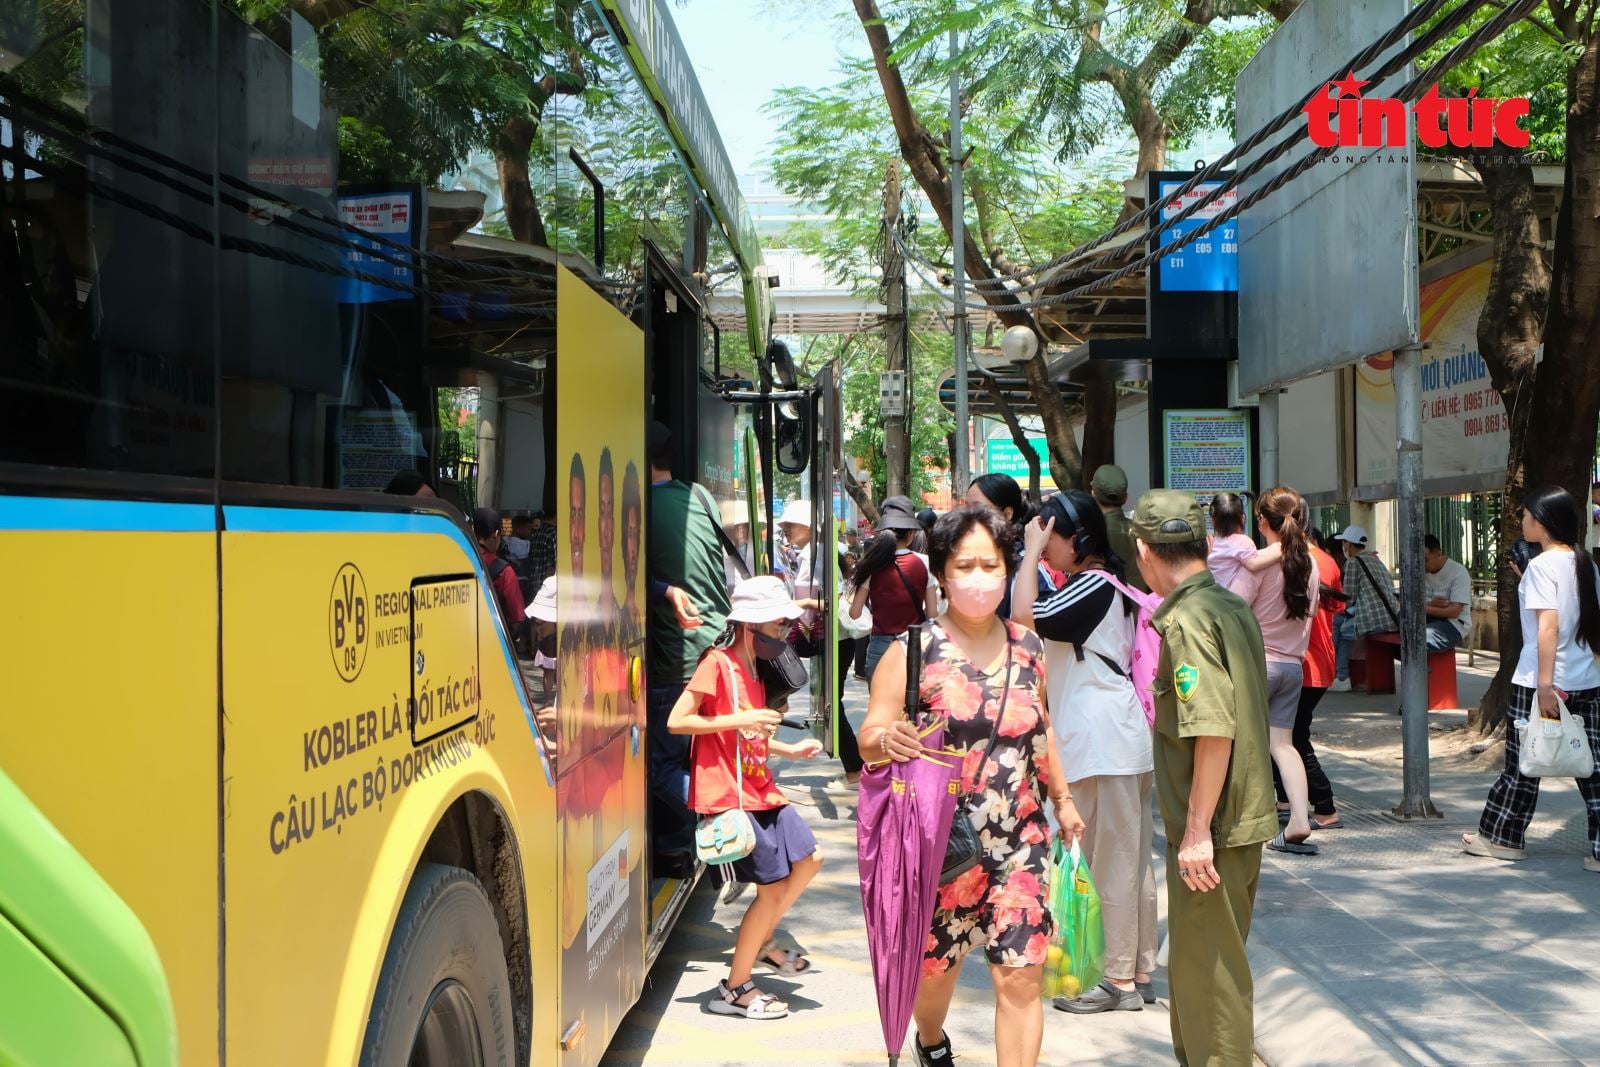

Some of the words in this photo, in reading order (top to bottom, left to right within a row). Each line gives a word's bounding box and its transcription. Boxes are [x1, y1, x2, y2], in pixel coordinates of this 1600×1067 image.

[1172, 229, 1182, 239] 12
[1224, 229, 1235, 239] 27
[1195, 243, 1212, 253] E05
[1221, 243, 1238, 253] E08
[1170, 258, 1184, 268] E11
[1444, 343, 1486, 390] QUẢNG
[1431, 394, 1446, 419] LIÊN
[1464, 390, 1483, 412] 0965
[1465, 417, 1483, 438] 0904
[1485, 413, 1500, 434] 869
[334, 574, 366, 649] BVB
[375, 588, 432, 618] REGIONAL
[433, 584, 470, 609] PARTNER
[375, 631, 384, 648] IN
[344, 646, 356, 672] 09
[304, 710, 377, 772] KOBLER
[382, 692, 402, 741] LÀ
[405, 679, 434, 731] ĐỐI
[437, 676, 460, 719] TÁC
[463, 665, 482, 708] CỦA
[269, 794, 315, 855] CÂU
[322, 778, 358, 835] LẠC
[363, 756, 387, 812] BỘ
[391, 730, 472, 794] DORTMUND
[475, 708, 496, 748] ĐỨC
[588, 880, 616, 933] GERMANY
